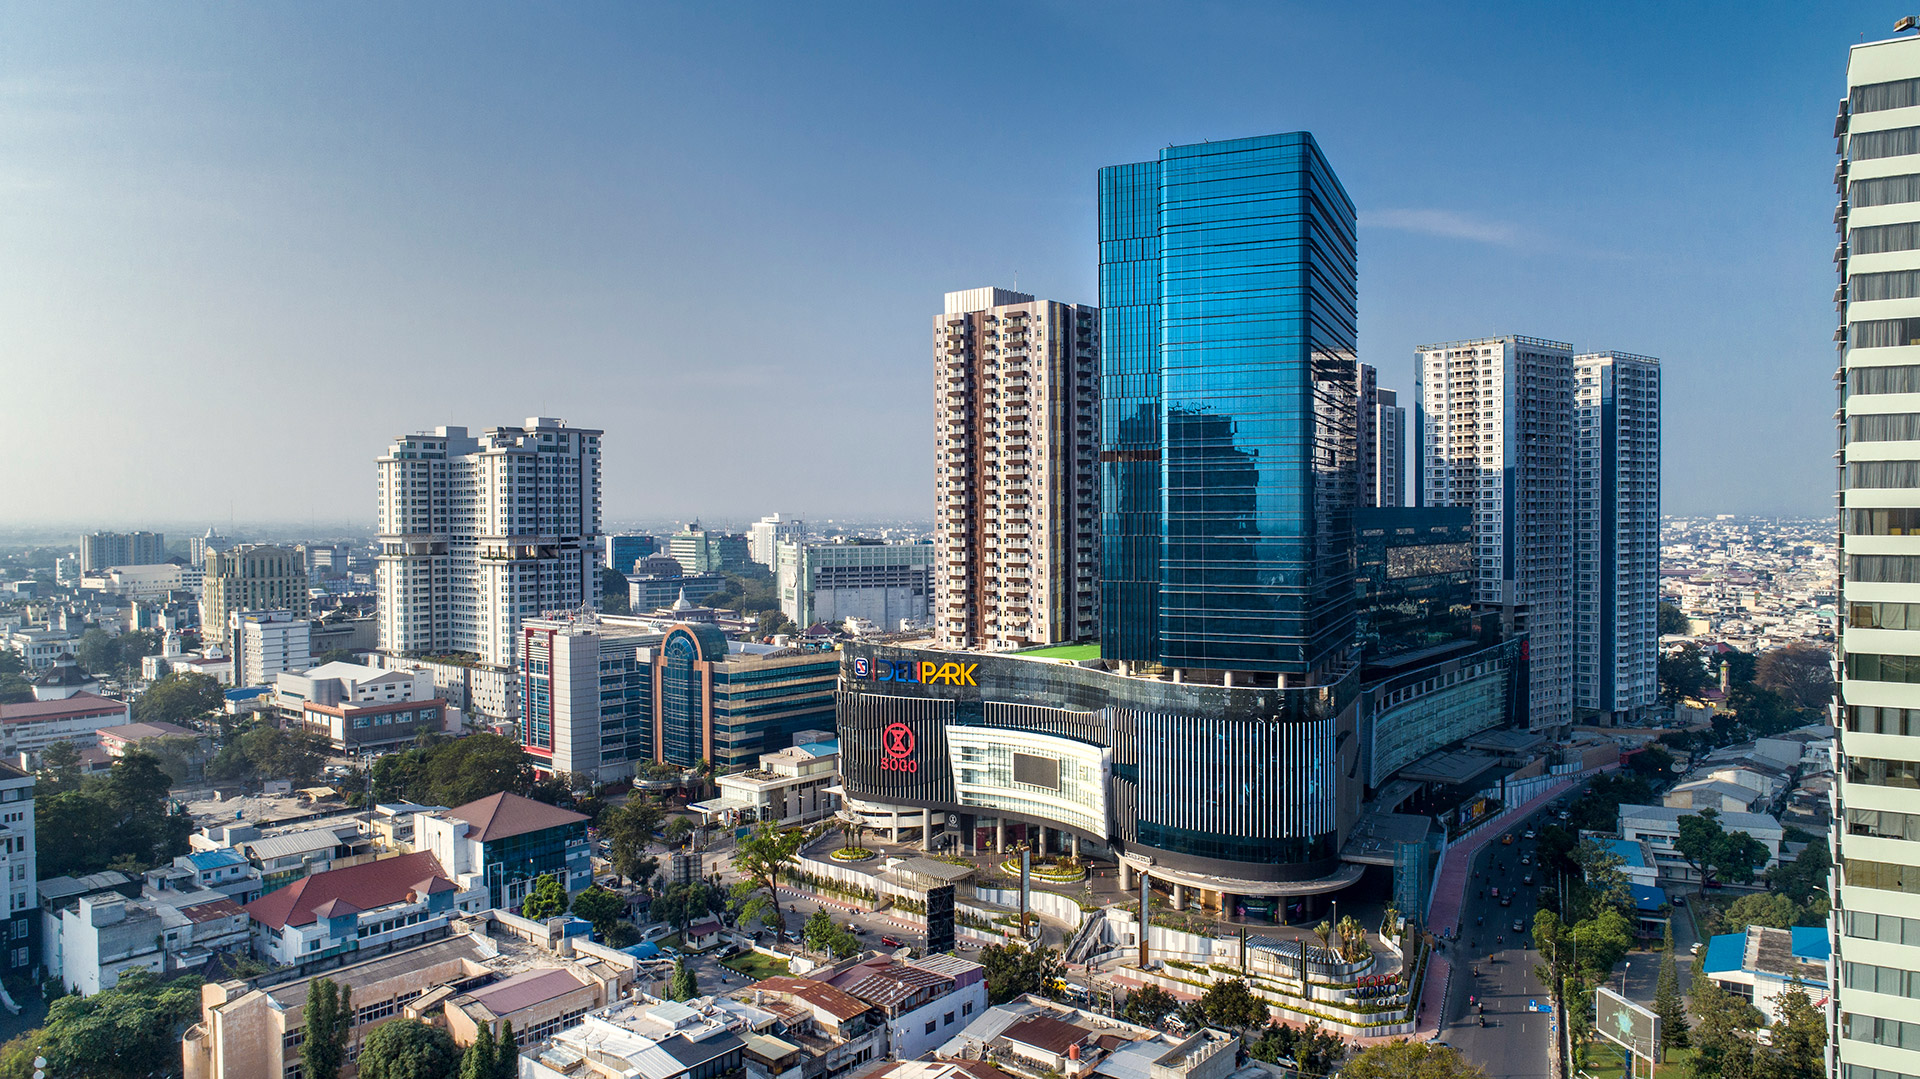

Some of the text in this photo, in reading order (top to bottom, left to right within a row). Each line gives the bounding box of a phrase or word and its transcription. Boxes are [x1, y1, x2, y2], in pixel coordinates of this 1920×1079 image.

[881, 757, 917, 773] SOGO
[1357, 972, 1398, 989] PODO
[1354, 983, 1399, 999] MORO
